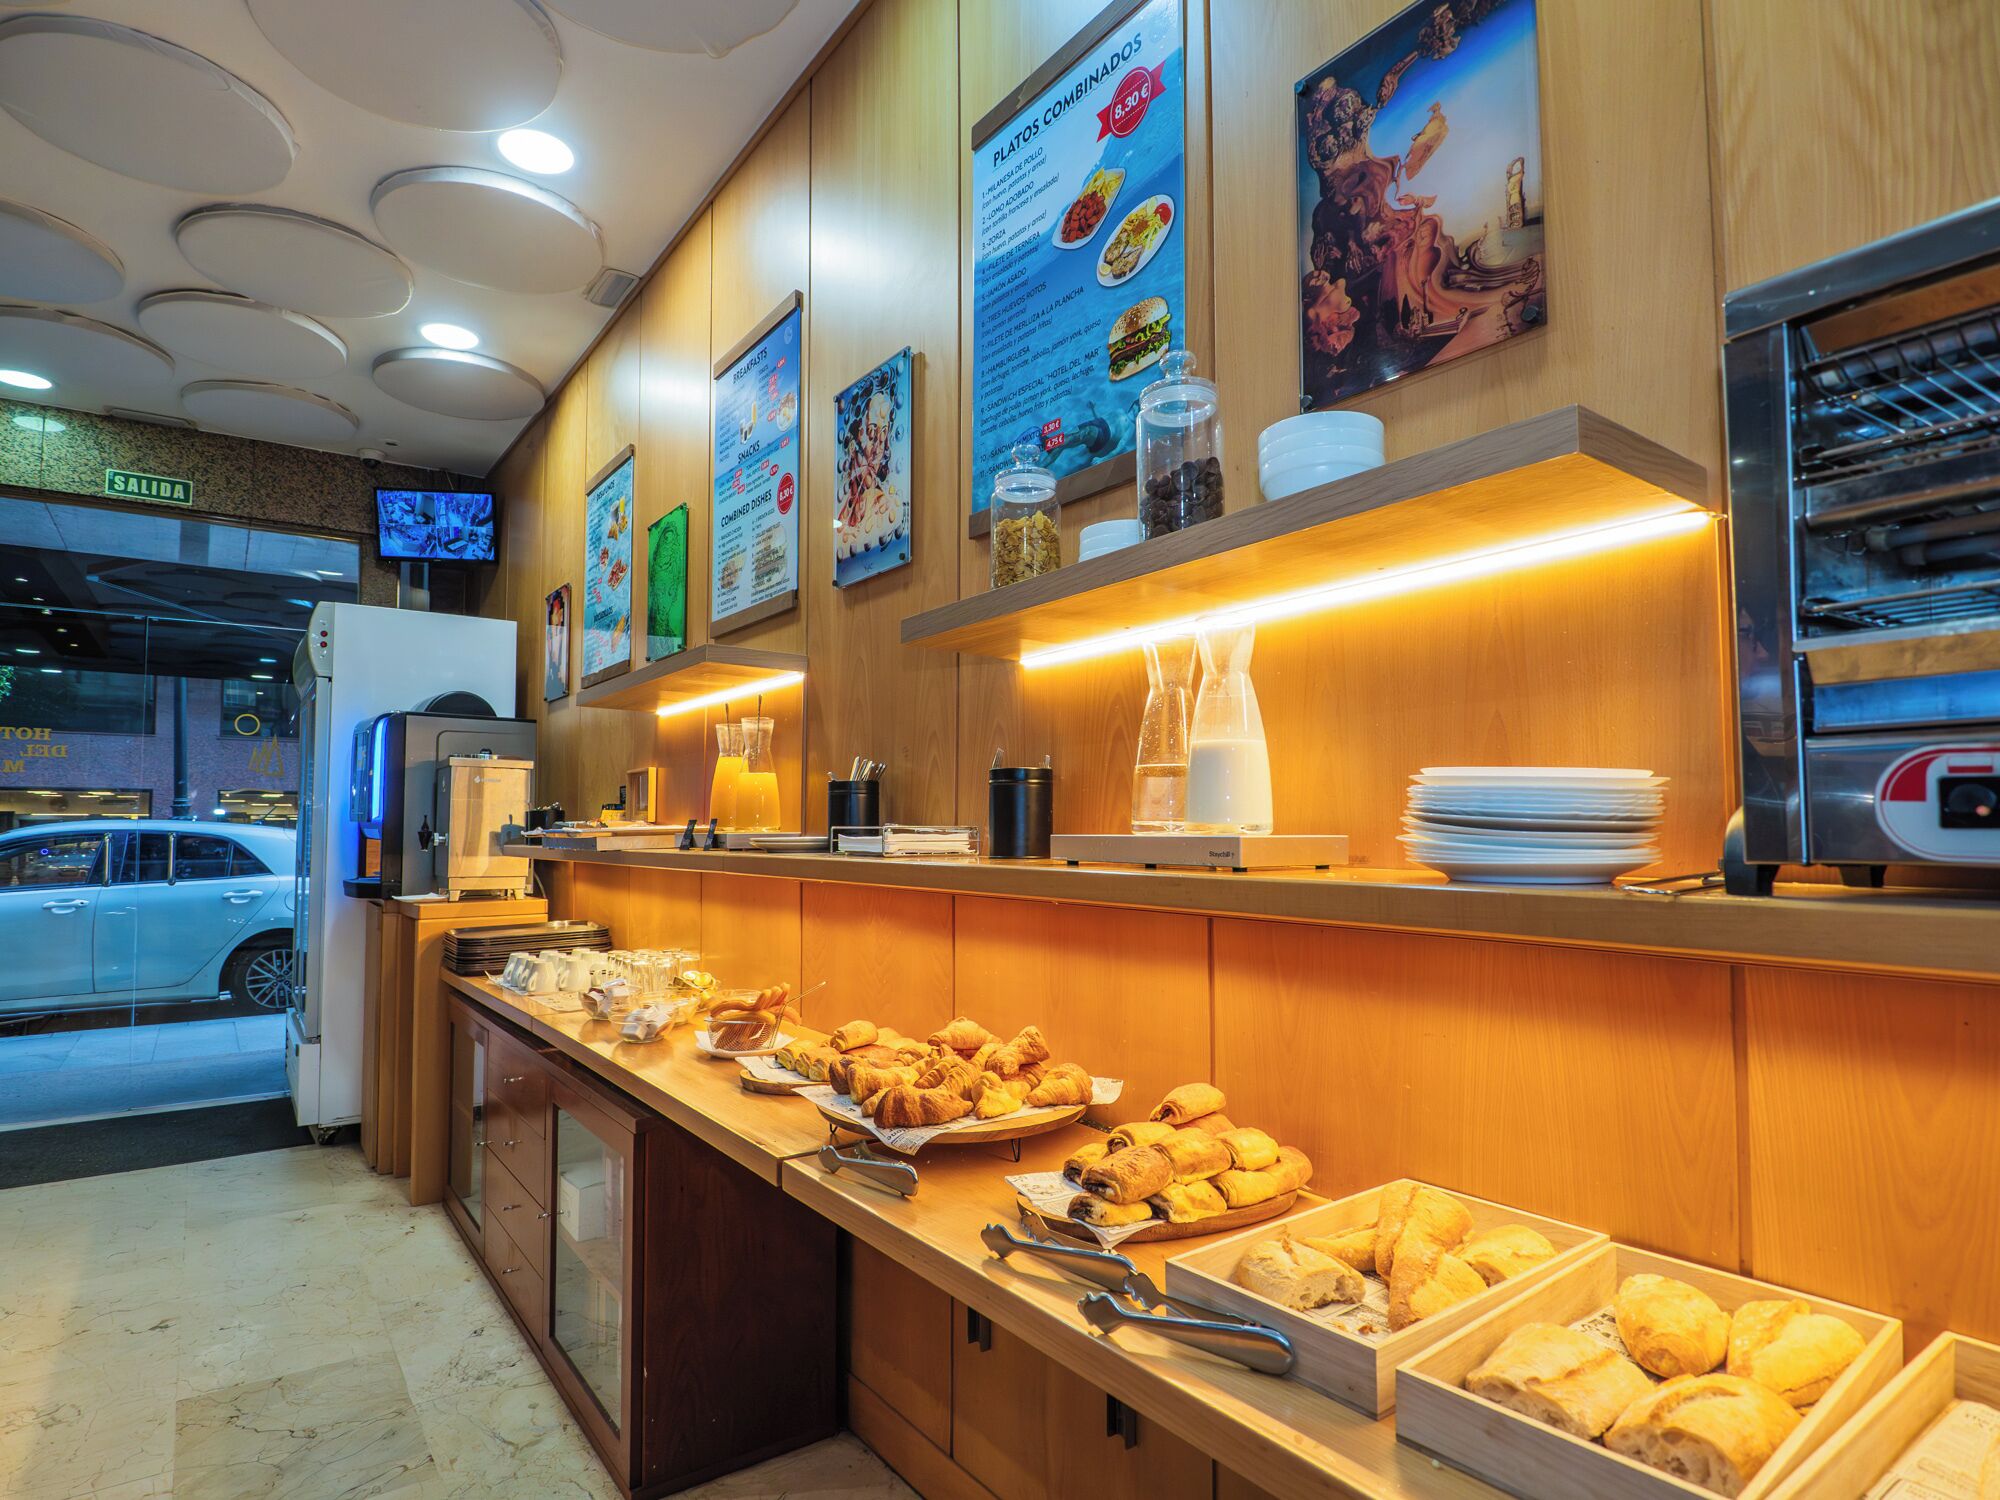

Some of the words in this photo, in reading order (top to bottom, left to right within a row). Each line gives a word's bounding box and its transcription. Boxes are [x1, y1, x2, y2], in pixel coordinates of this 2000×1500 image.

[994, 118, 1039, 167] PLATOS
[1044, 33, 1142, 127] COMBINADOS
[1115, 91, 1139, 122] 8,30
[1141, 83, 1149, 100] €
[1016, 164, 1023, 174] DE
[1024, 148, 1043, 167] POLLO
[1007, 181, 1034, 207] ADOBADO
[1009, 172, 1027, 191] patatas
[1008, 249, 1014, 259] DE
[1016, 231, 1040, 253] TERNERA
[1009, 227, 1027, 244] patatas
[1008, 268, 1027, 285] ASADO
[1003, 296, 1025, 315] HUEVOS
[1027, 282, 1047, 299] ROTOS
[1006, 328, 1014, 338] DE
[1015, 313, 1040, 333] MERLUZA
[1041, 309, 1045, 317] A
[1047, 304, 1054, 313] LA
[1056, 286, 1084, 309] PLANCHA
[733, 347, 768, 385] BREAKFASTS
[1019, 378, 1044, 396] ESPECIAL
[1070, 359, 1081, 370] DEL
[738, 440, 760, 464] SNACKS
[1047, 439, 1059, 449] 4,75
[114, 475, 185, 499] SALIDA
[789, 484, 793, 494] €
[720, 501, 749, 528] COMBINED
[751, 488, 771, 510] DISHES
